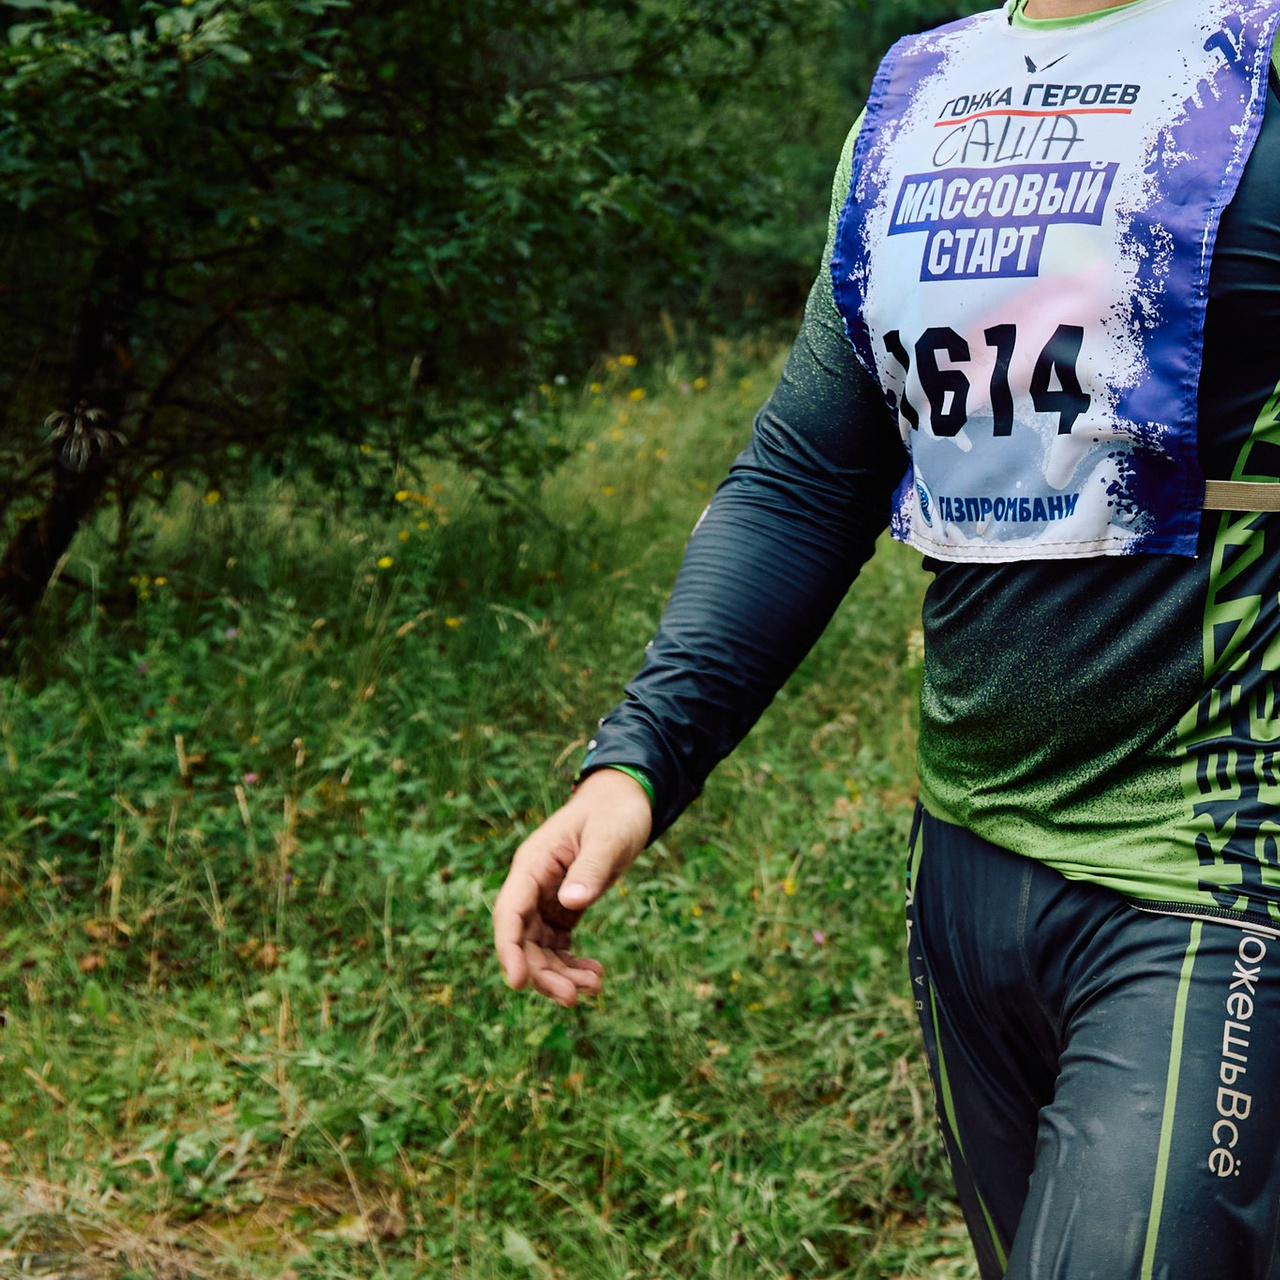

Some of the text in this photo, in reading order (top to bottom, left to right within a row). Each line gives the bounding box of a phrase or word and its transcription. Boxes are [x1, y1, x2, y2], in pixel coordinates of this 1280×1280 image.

[938, 83, 1141, 119] ГОНКА ГЕРОЕВ
[932, 114, 1085, 167] САША
[895, 161, 1109, 226] МАССОВЫЙ
[927, 225, 1040, 275] СТАРТ
[882, 323, 1092, 437] 1614
[938, 493, 1080, 523] ГАЗПРОМБАНК
